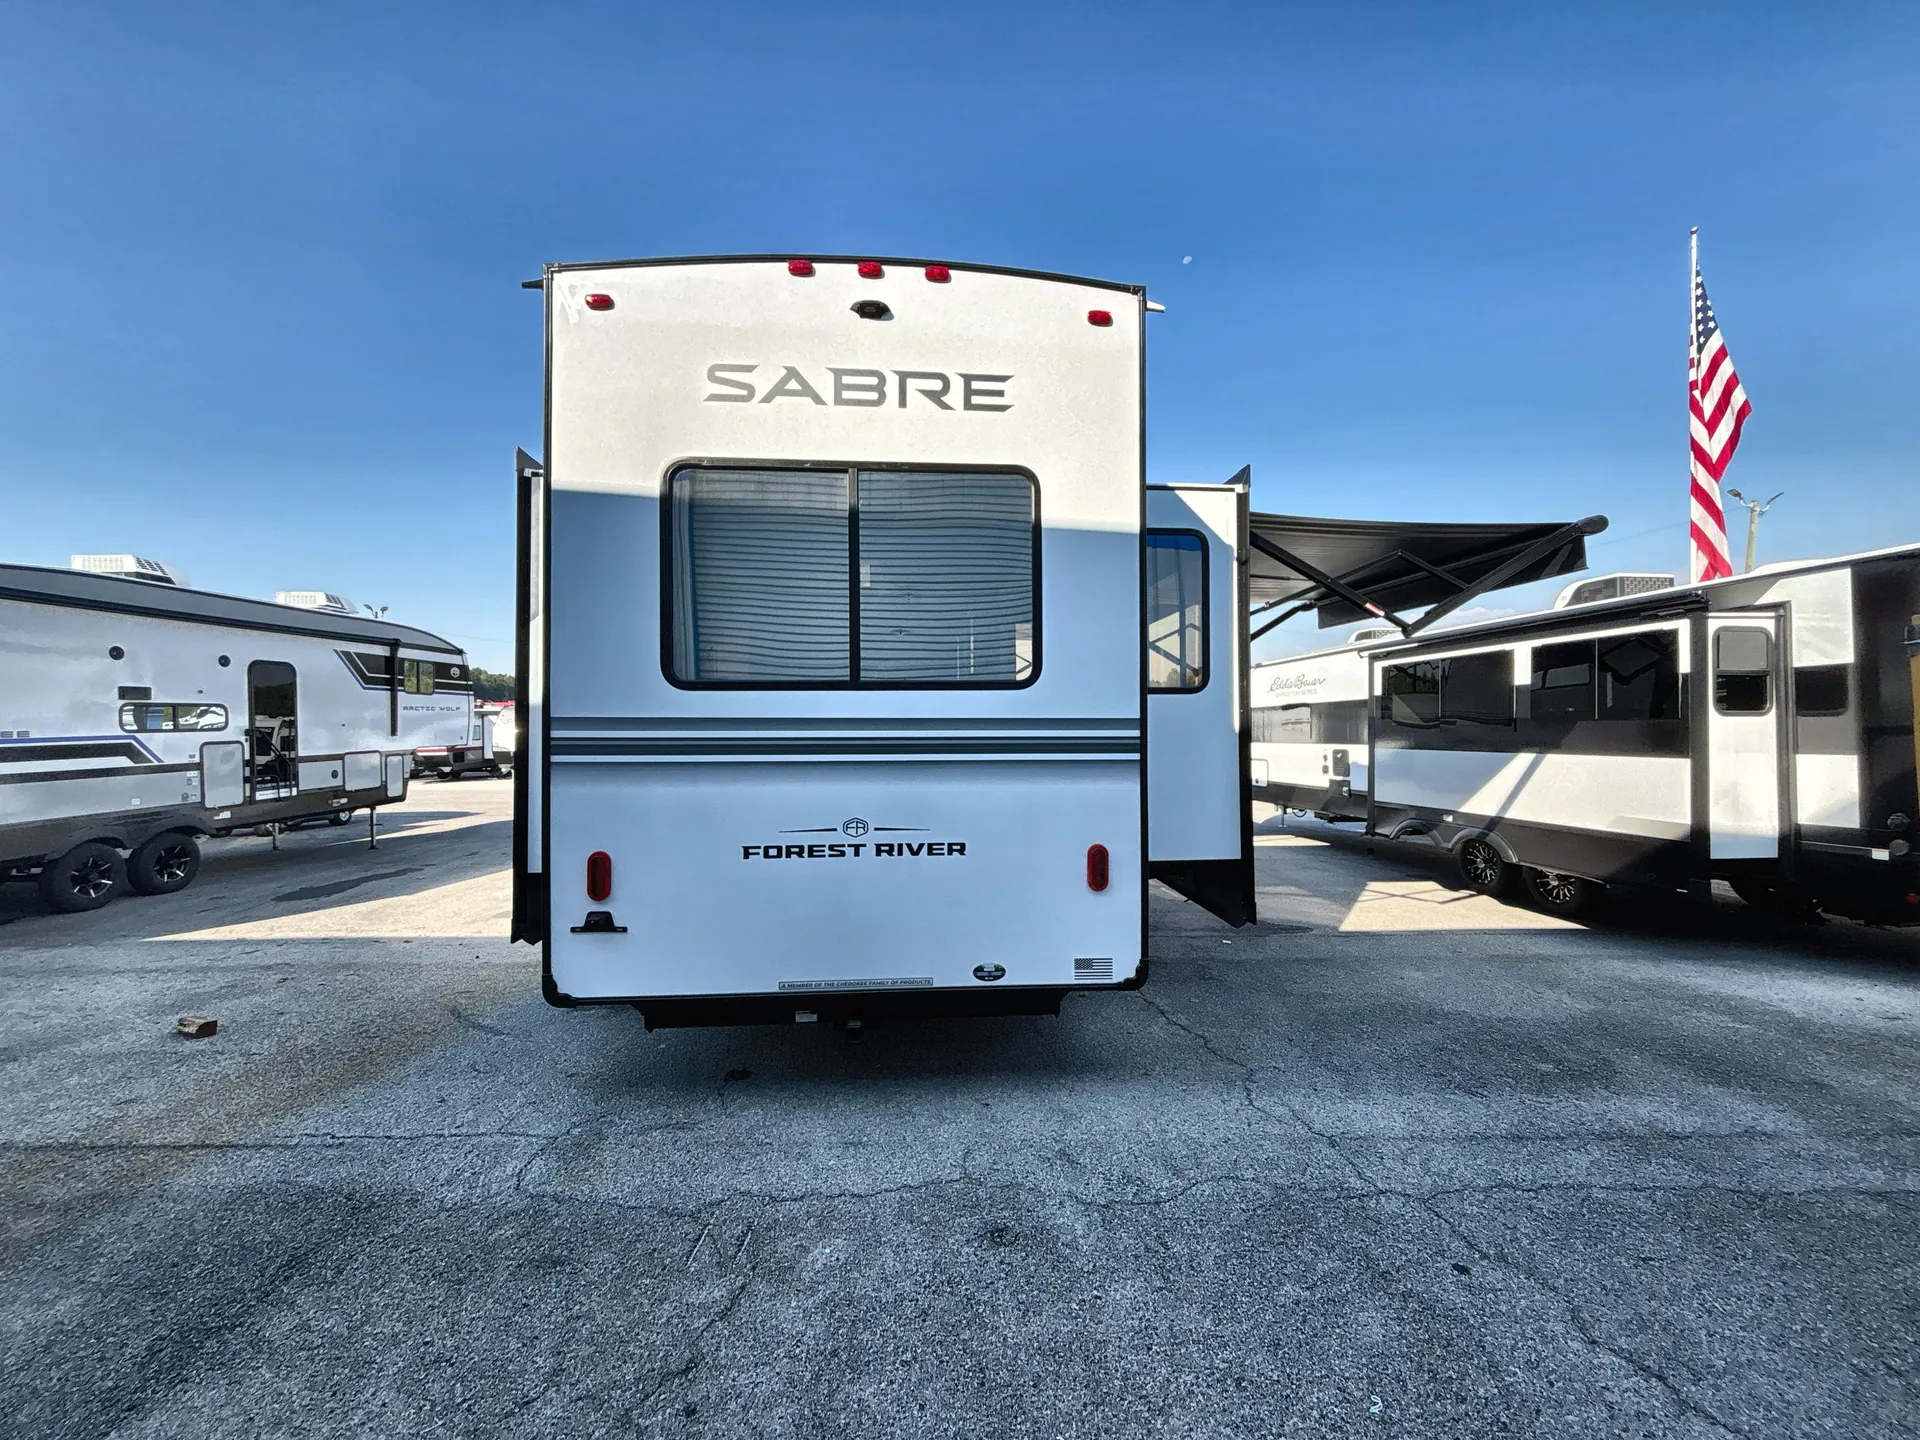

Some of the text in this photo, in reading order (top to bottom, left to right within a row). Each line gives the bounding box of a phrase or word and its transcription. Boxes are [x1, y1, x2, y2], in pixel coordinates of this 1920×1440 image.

[703, 363, 1015, 412] SABRE
[1267, 673, 1326, 693] Eddie Bauer
[845, 820, 866, 835] FR
[741, 842, 967, 860] FOREST RIVER
